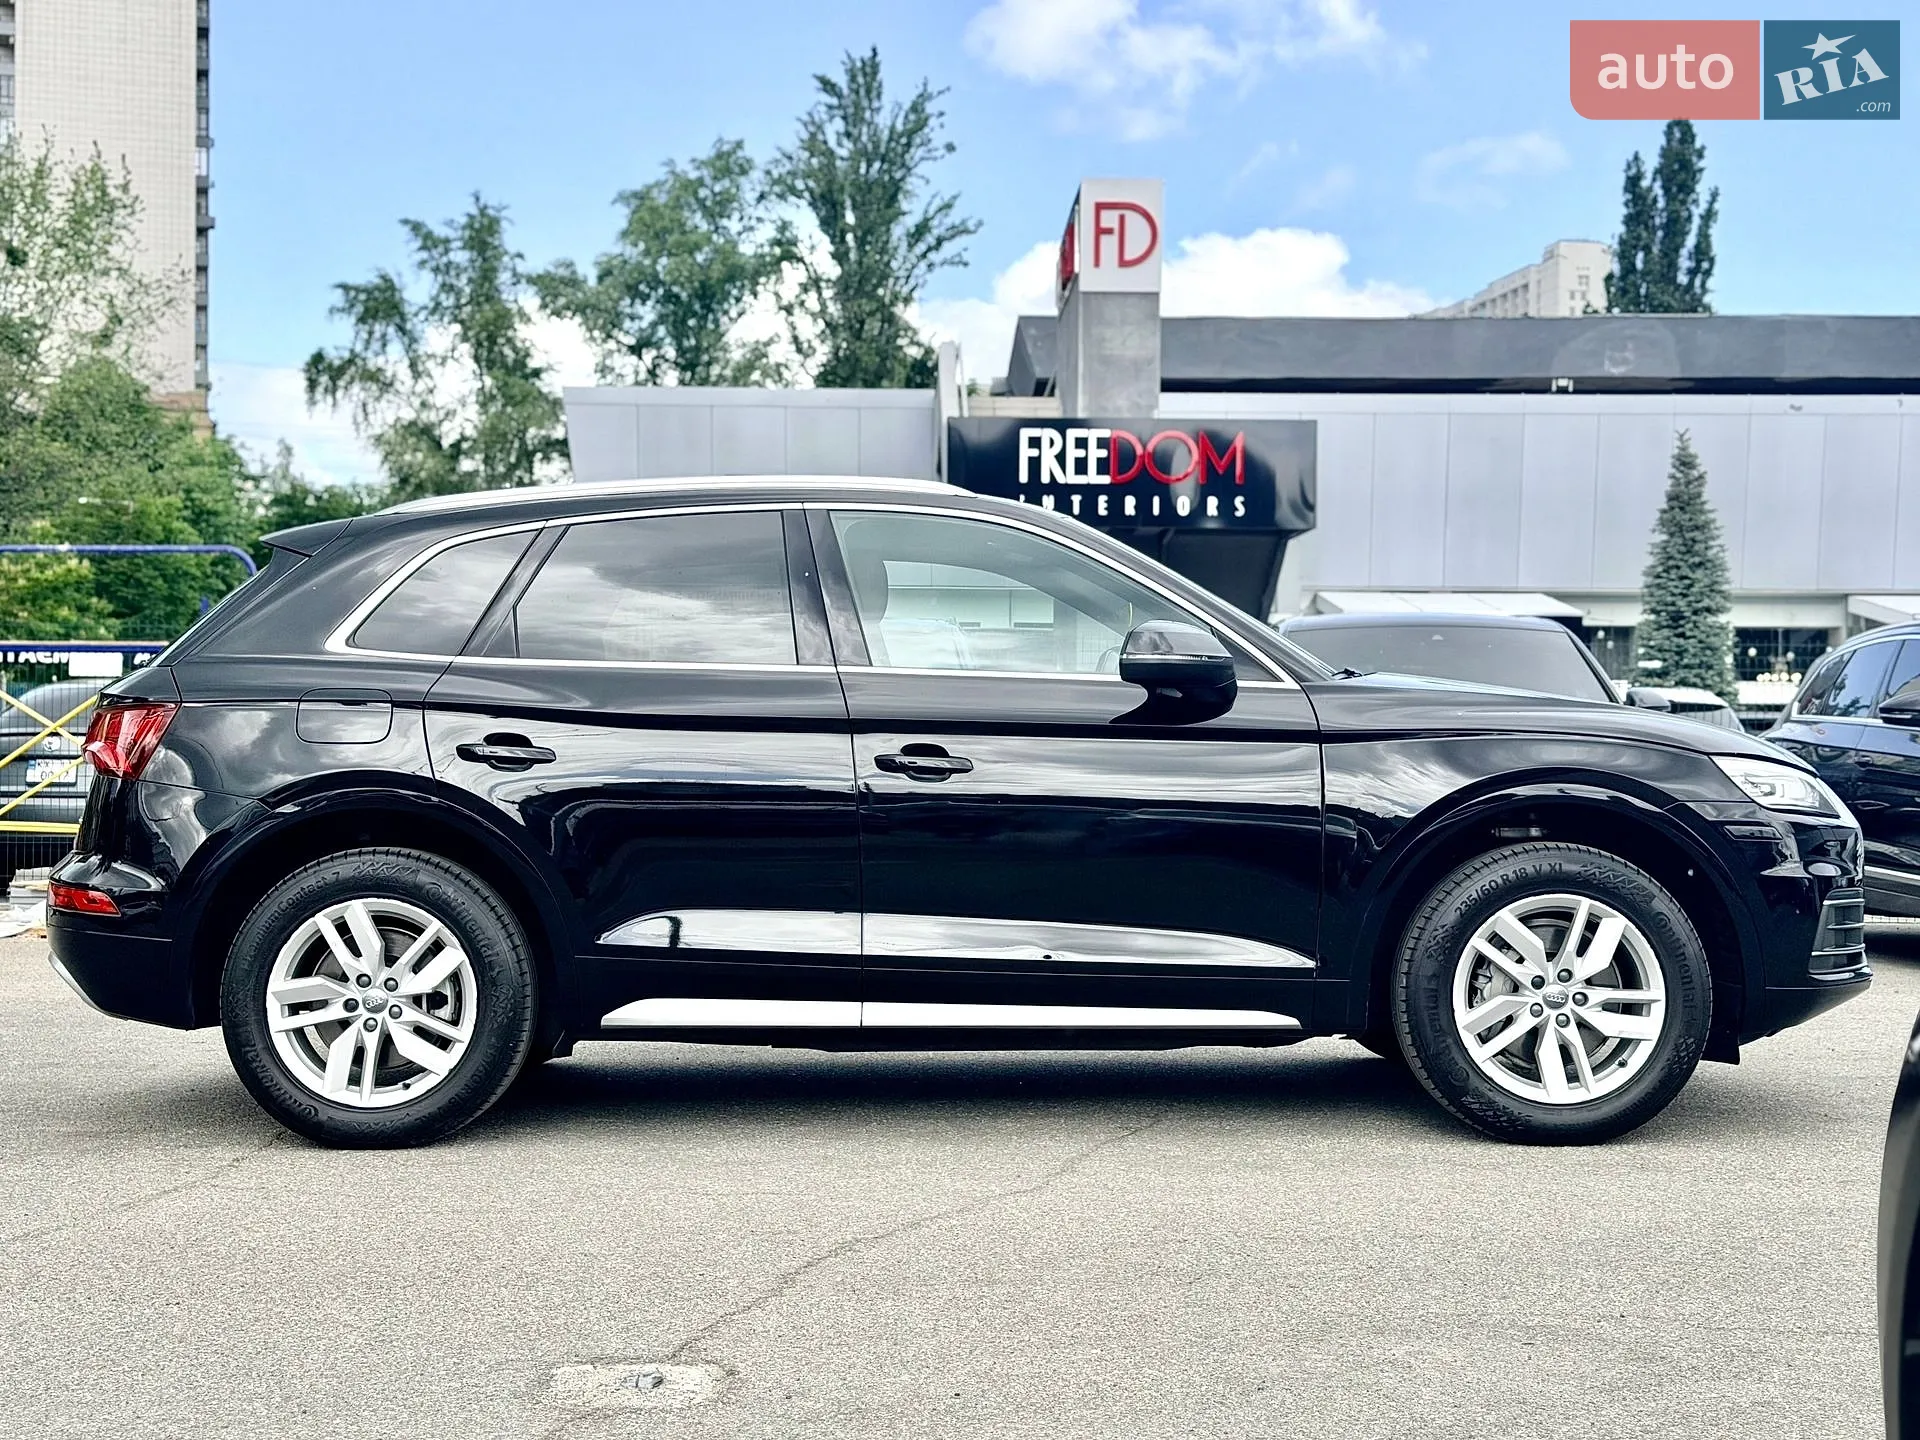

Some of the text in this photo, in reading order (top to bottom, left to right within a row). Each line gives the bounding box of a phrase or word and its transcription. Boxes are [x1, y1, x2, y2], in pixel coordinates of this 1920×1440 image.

[1094, 202, 1158, 268] FD
[1019, 427, 1245, 484] FREEDOM
[1019, 494, 1246, 517] NTERIORS
[1454, 879, 1500, 917] 235/60
[1500, 873, 1512, 886] R
[1512, 867, 1529, 881] 18
[1532, 863, 1543, 874] V
